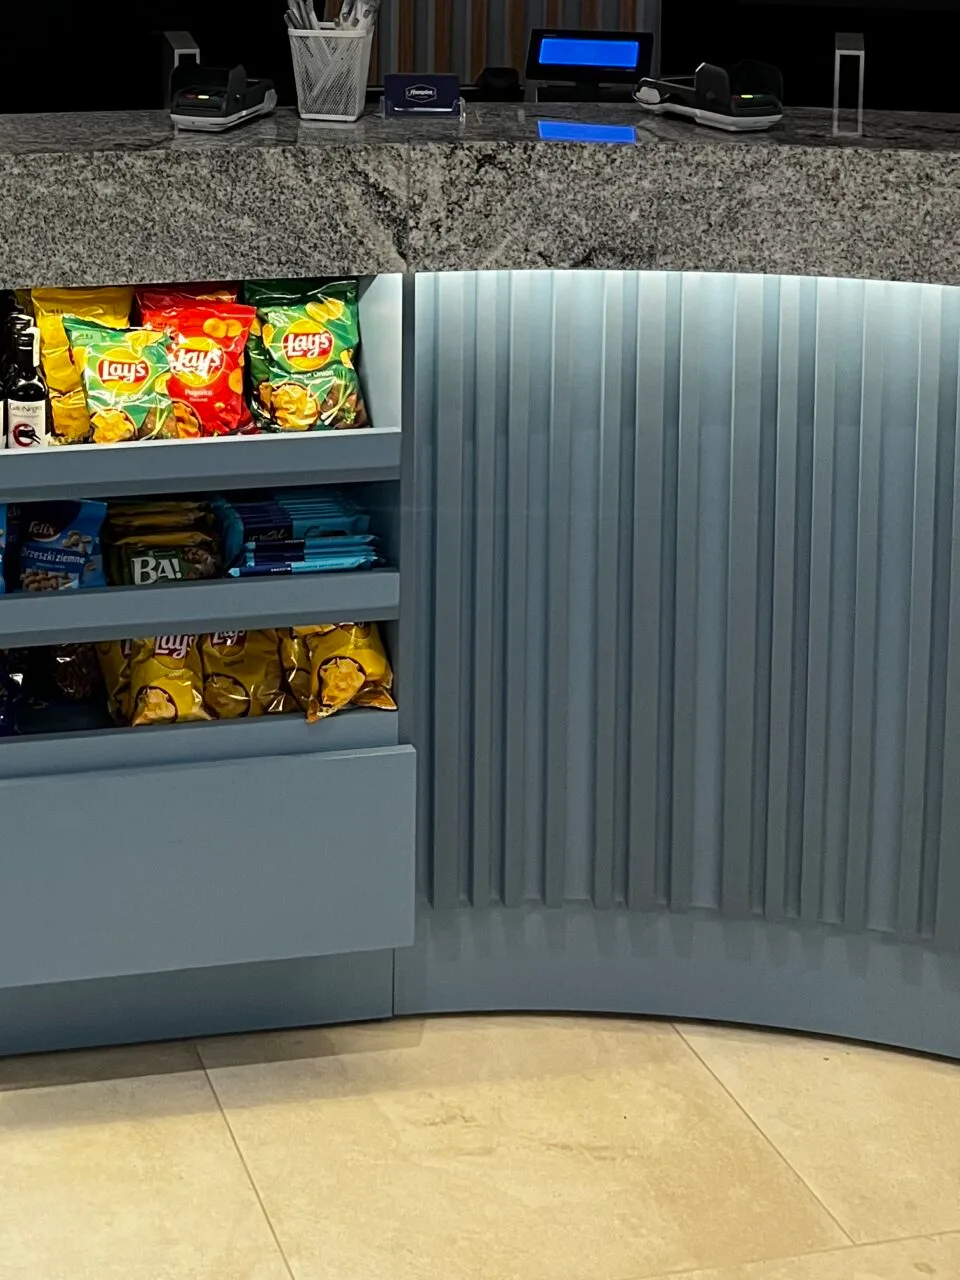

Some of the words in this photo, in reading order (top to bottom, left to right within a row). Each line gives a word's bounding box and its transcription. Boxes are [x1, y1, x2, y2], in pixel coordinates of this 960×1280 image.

[288, 332, 331, 359] Lay's
[102, 359, 147, 383] Lay's
[28, 521, 55, 536] felix
[55, 553, 86, 565] ziemne
[130, 556, 182, 585] BA!
